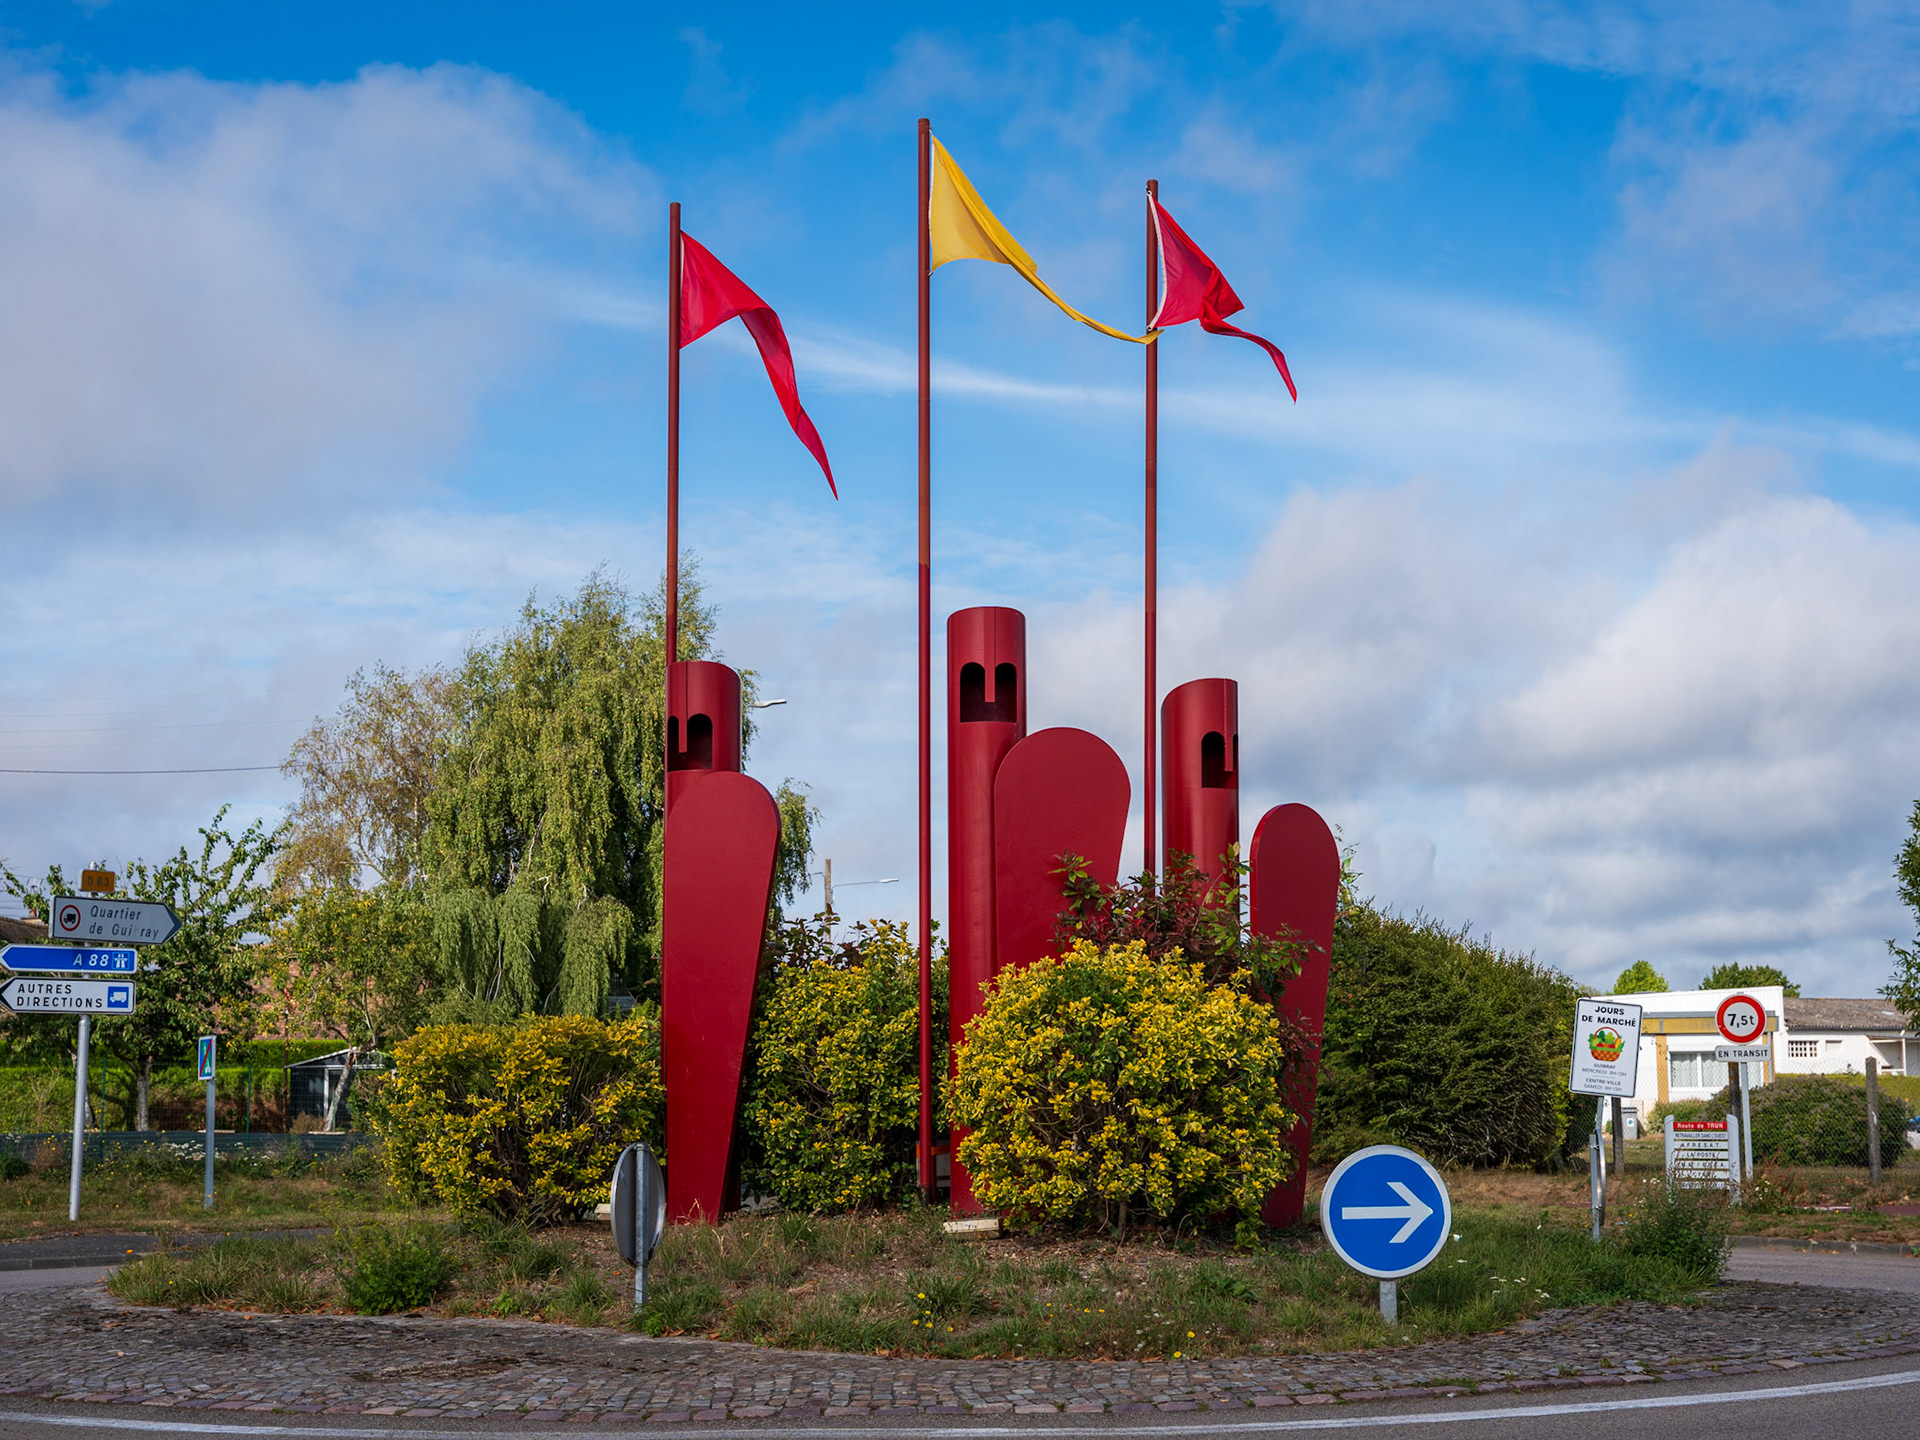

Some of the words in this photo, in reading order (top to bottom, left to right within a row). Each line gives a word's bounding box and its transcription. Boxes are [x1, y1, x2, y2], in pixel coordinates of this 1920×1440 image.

[87, 876, 94, 886] D
[97, 877, 110, 887] 63
[90, 905, 141, 921] Quartier
[89, 923, 103, 935] de
[112, 923, 159, 940] Guiray
[73, 953, 82, 966] A
[88, 953, 109, 967] 88
[17, 983, 72, 994] AUTRES
[16, 996, 103, 1008] DIRECTIONS
[1594, 1006, 1625, 1015] JOURS
[1581, 1015, 1593, 1023] DE
[1597, 1016, 1636, 1027] MARCHÉ
[1718, 1050, 1729, 1058] EN
[1733, 1049, 1768, 1058] TRANSIT
[1581, 1067, 1608, 1075] MERCREDI
[1585, 1077, 1621, 1086] CENTRE-VILLE
